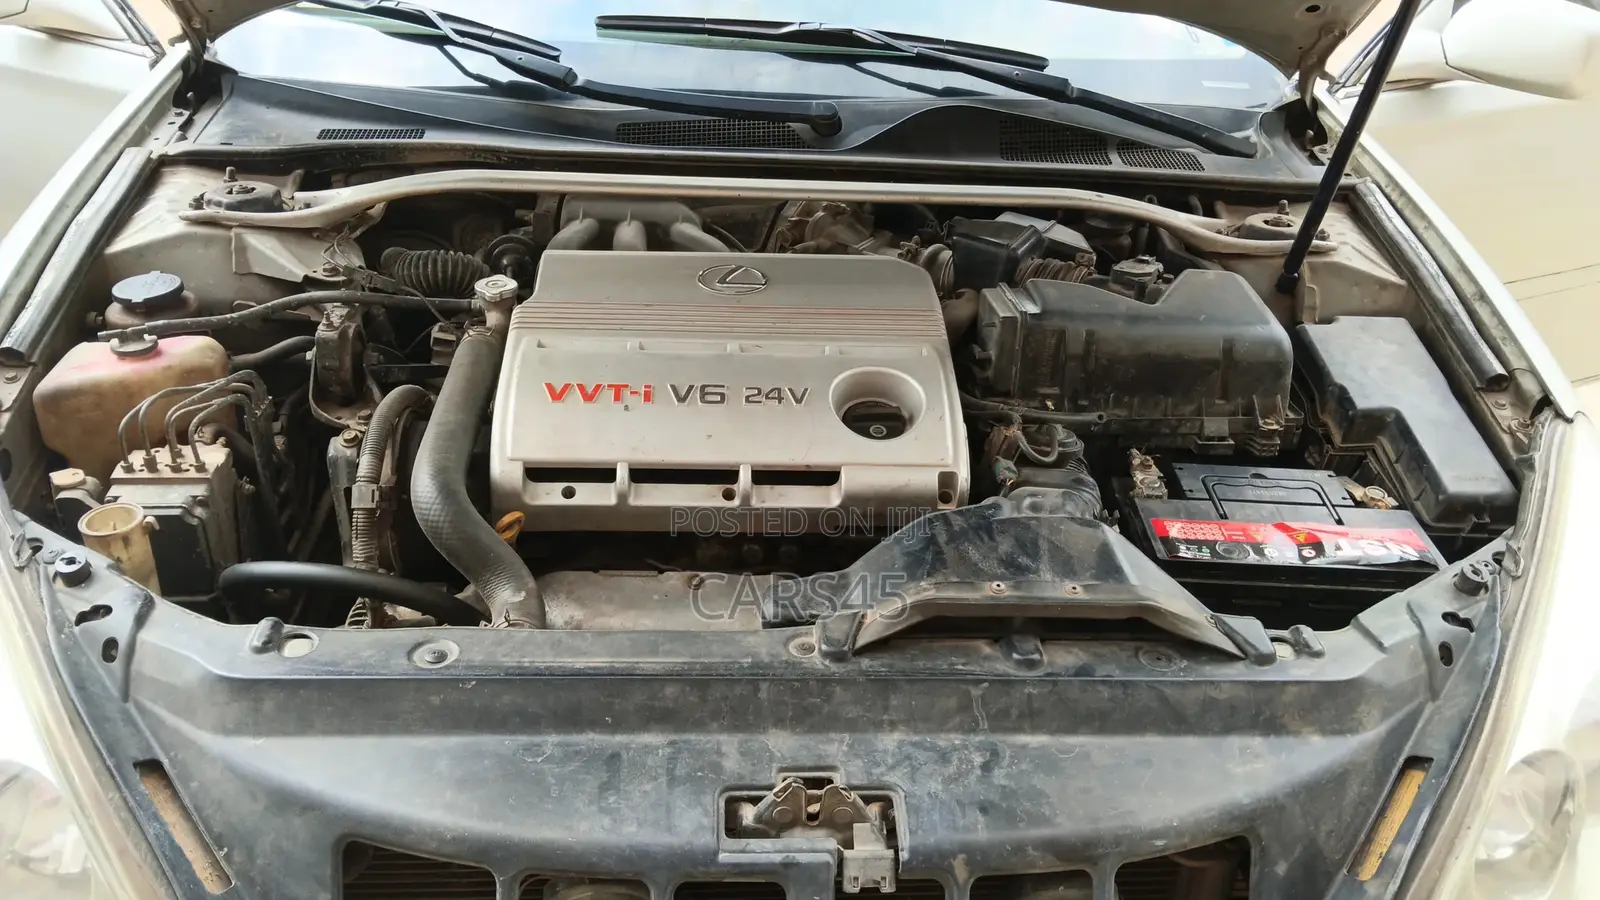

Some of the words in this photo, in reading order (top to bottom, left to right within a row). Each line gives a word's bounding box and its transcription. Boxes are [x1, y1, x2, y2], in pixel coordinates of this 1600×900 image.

[543, 382, 653, 404] VVT-i
[668, 383, 728, 406] V6
[743, 386, 810, 408] 24V
